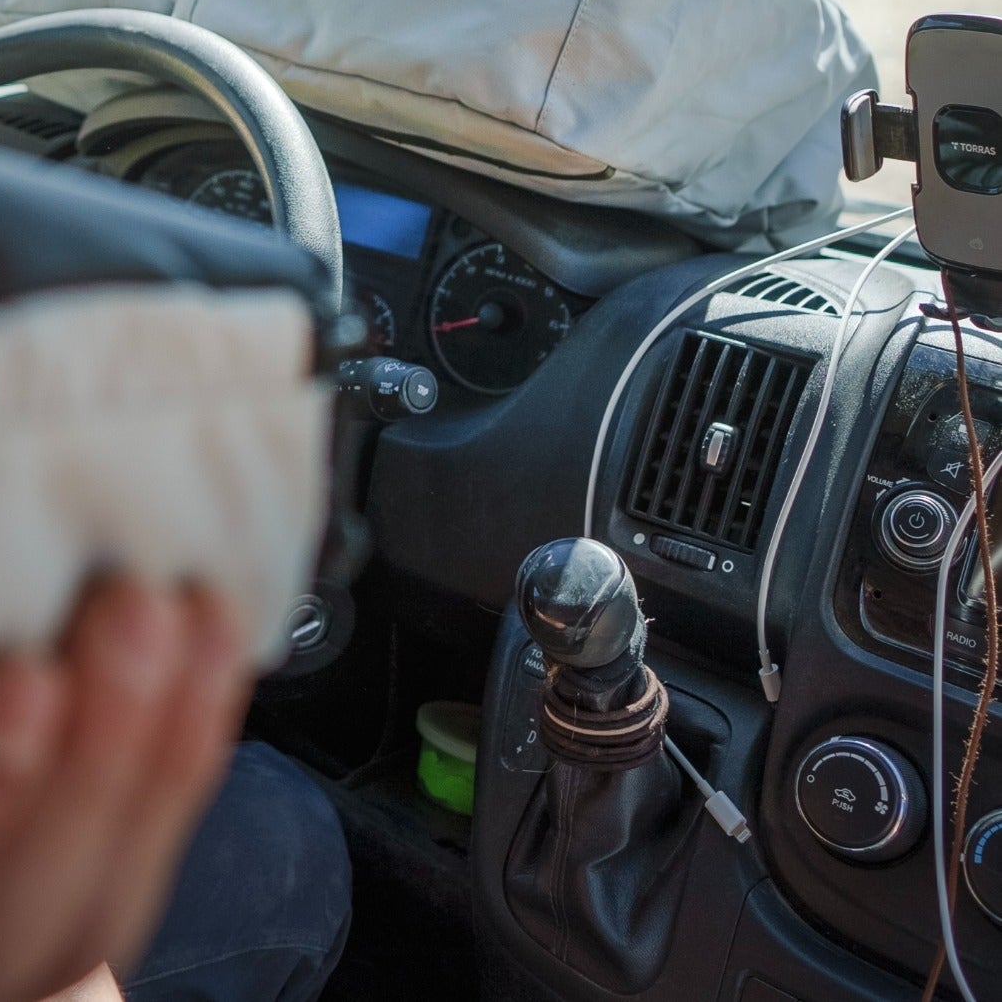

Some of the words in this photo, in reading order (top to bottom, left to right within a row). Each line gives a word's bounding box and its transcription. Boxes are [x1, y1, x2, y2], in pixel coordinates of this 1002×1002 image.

[960, 142, 996, 156] TORRAS
[867, 474, 894, 488] VOLUME
[946, 631, 977, 648] RADIO
[526, 730, 537, 743] D
[831, 798, 854, 813] PUSH
